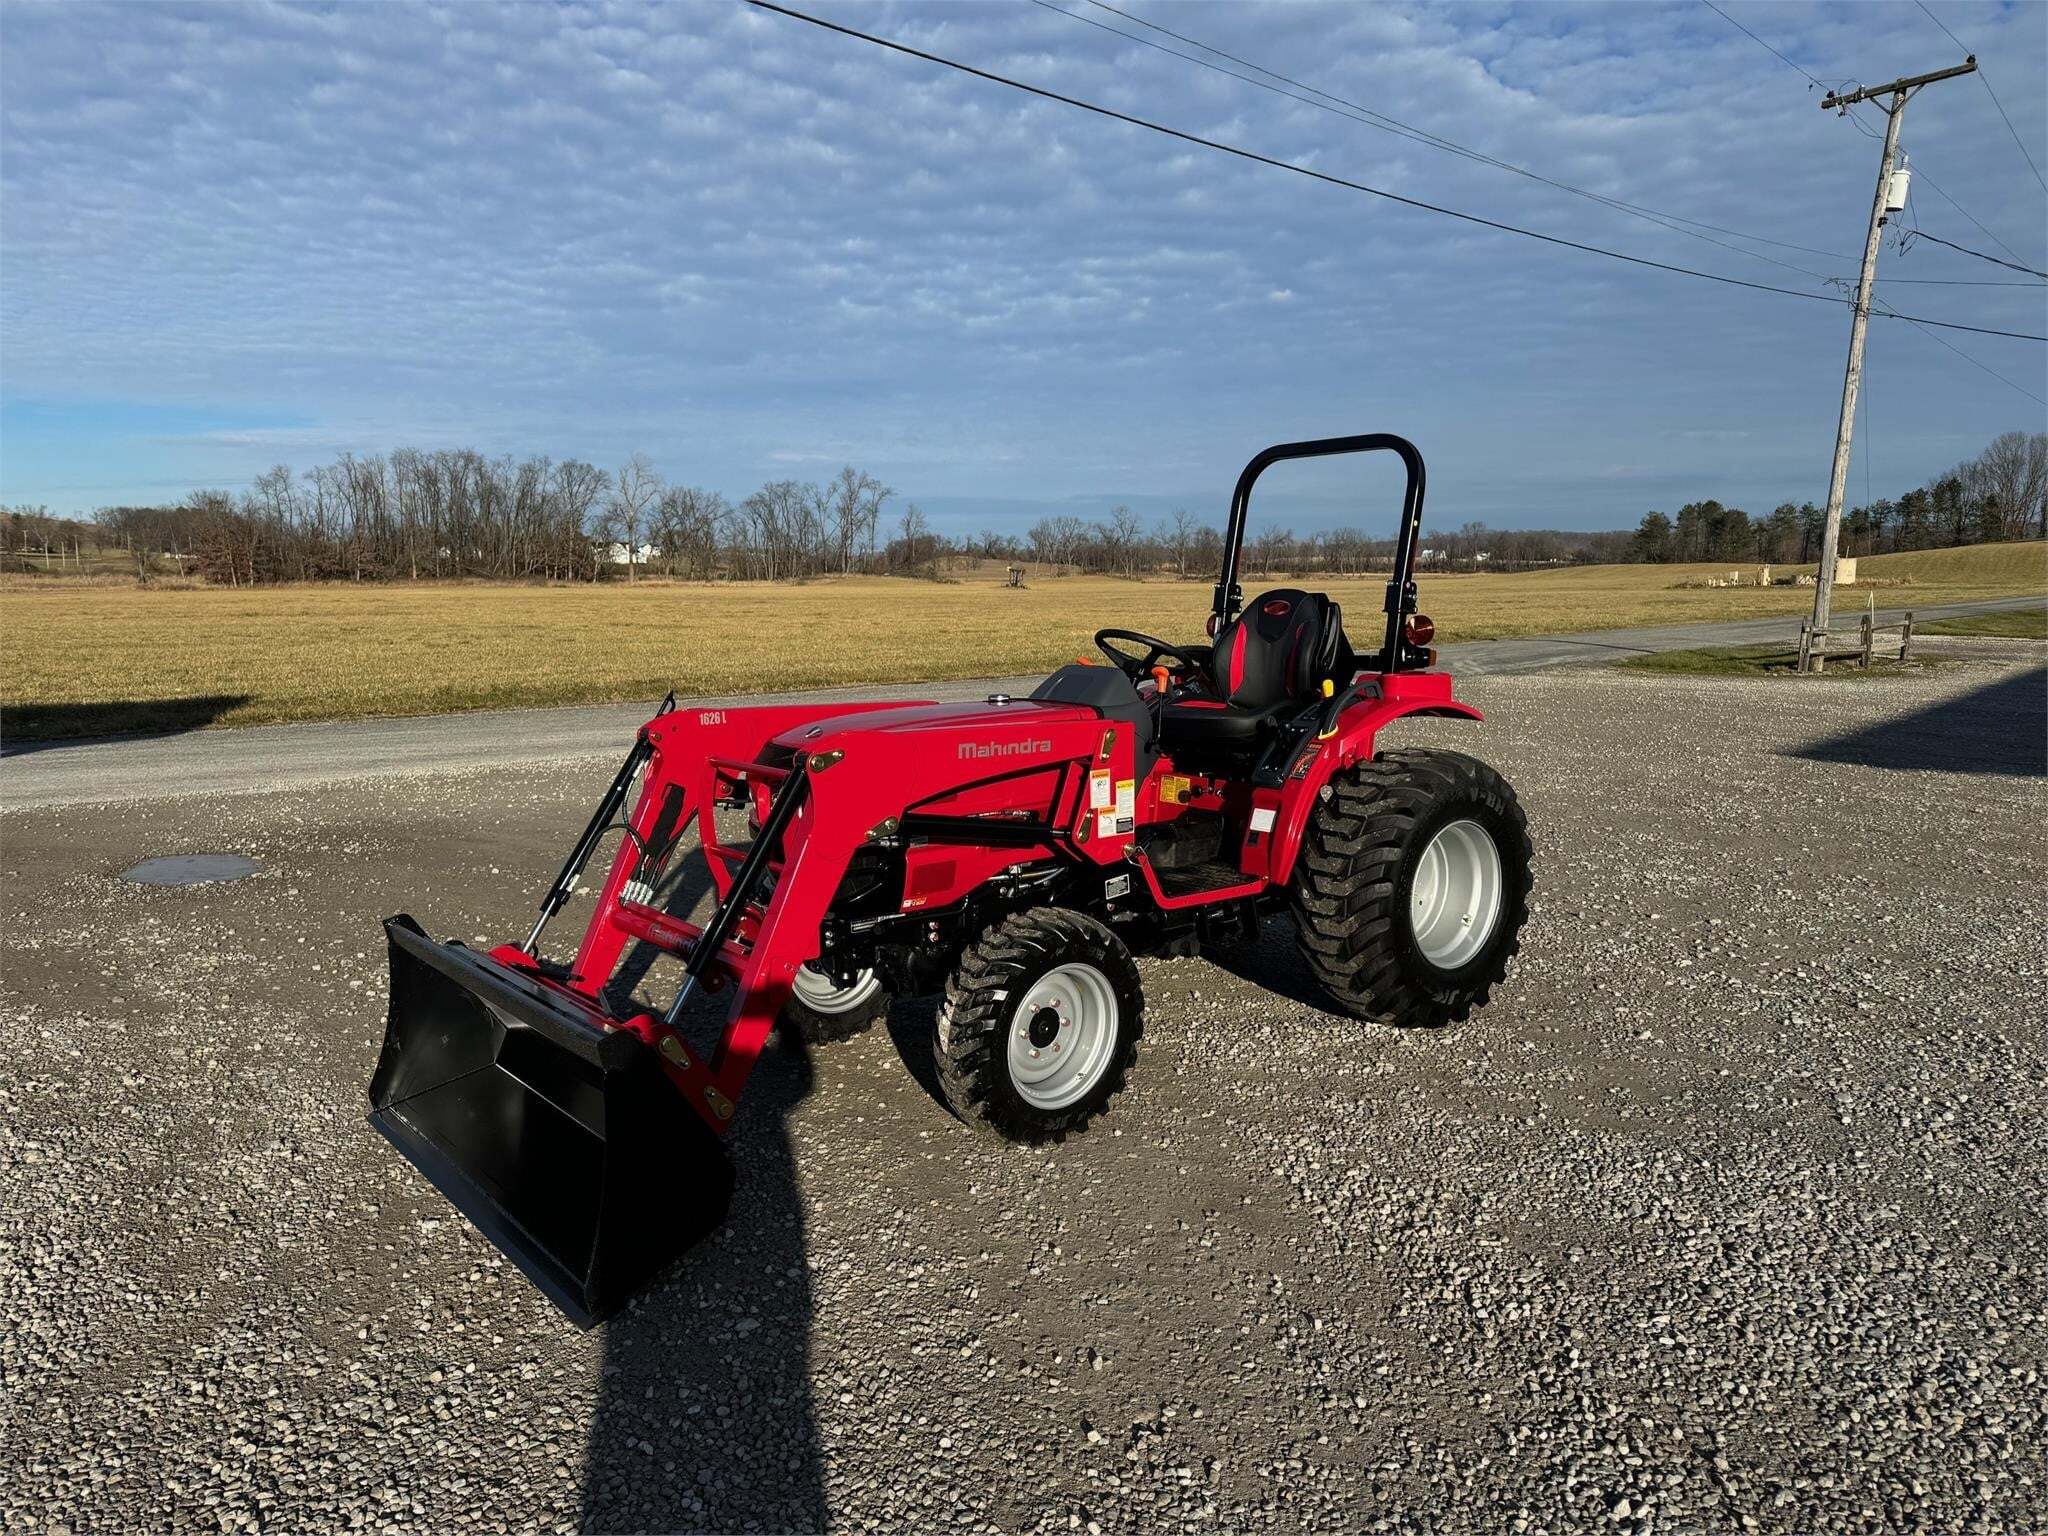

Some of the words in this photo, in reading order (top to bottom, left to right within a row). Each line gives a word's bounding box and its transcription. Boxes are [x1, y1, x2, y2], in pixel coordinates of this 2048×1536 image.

[699, 711, 721, 726] 1626
[721, 711, 727, 724] L
[958, 738, 1051, 759] Mahindra
